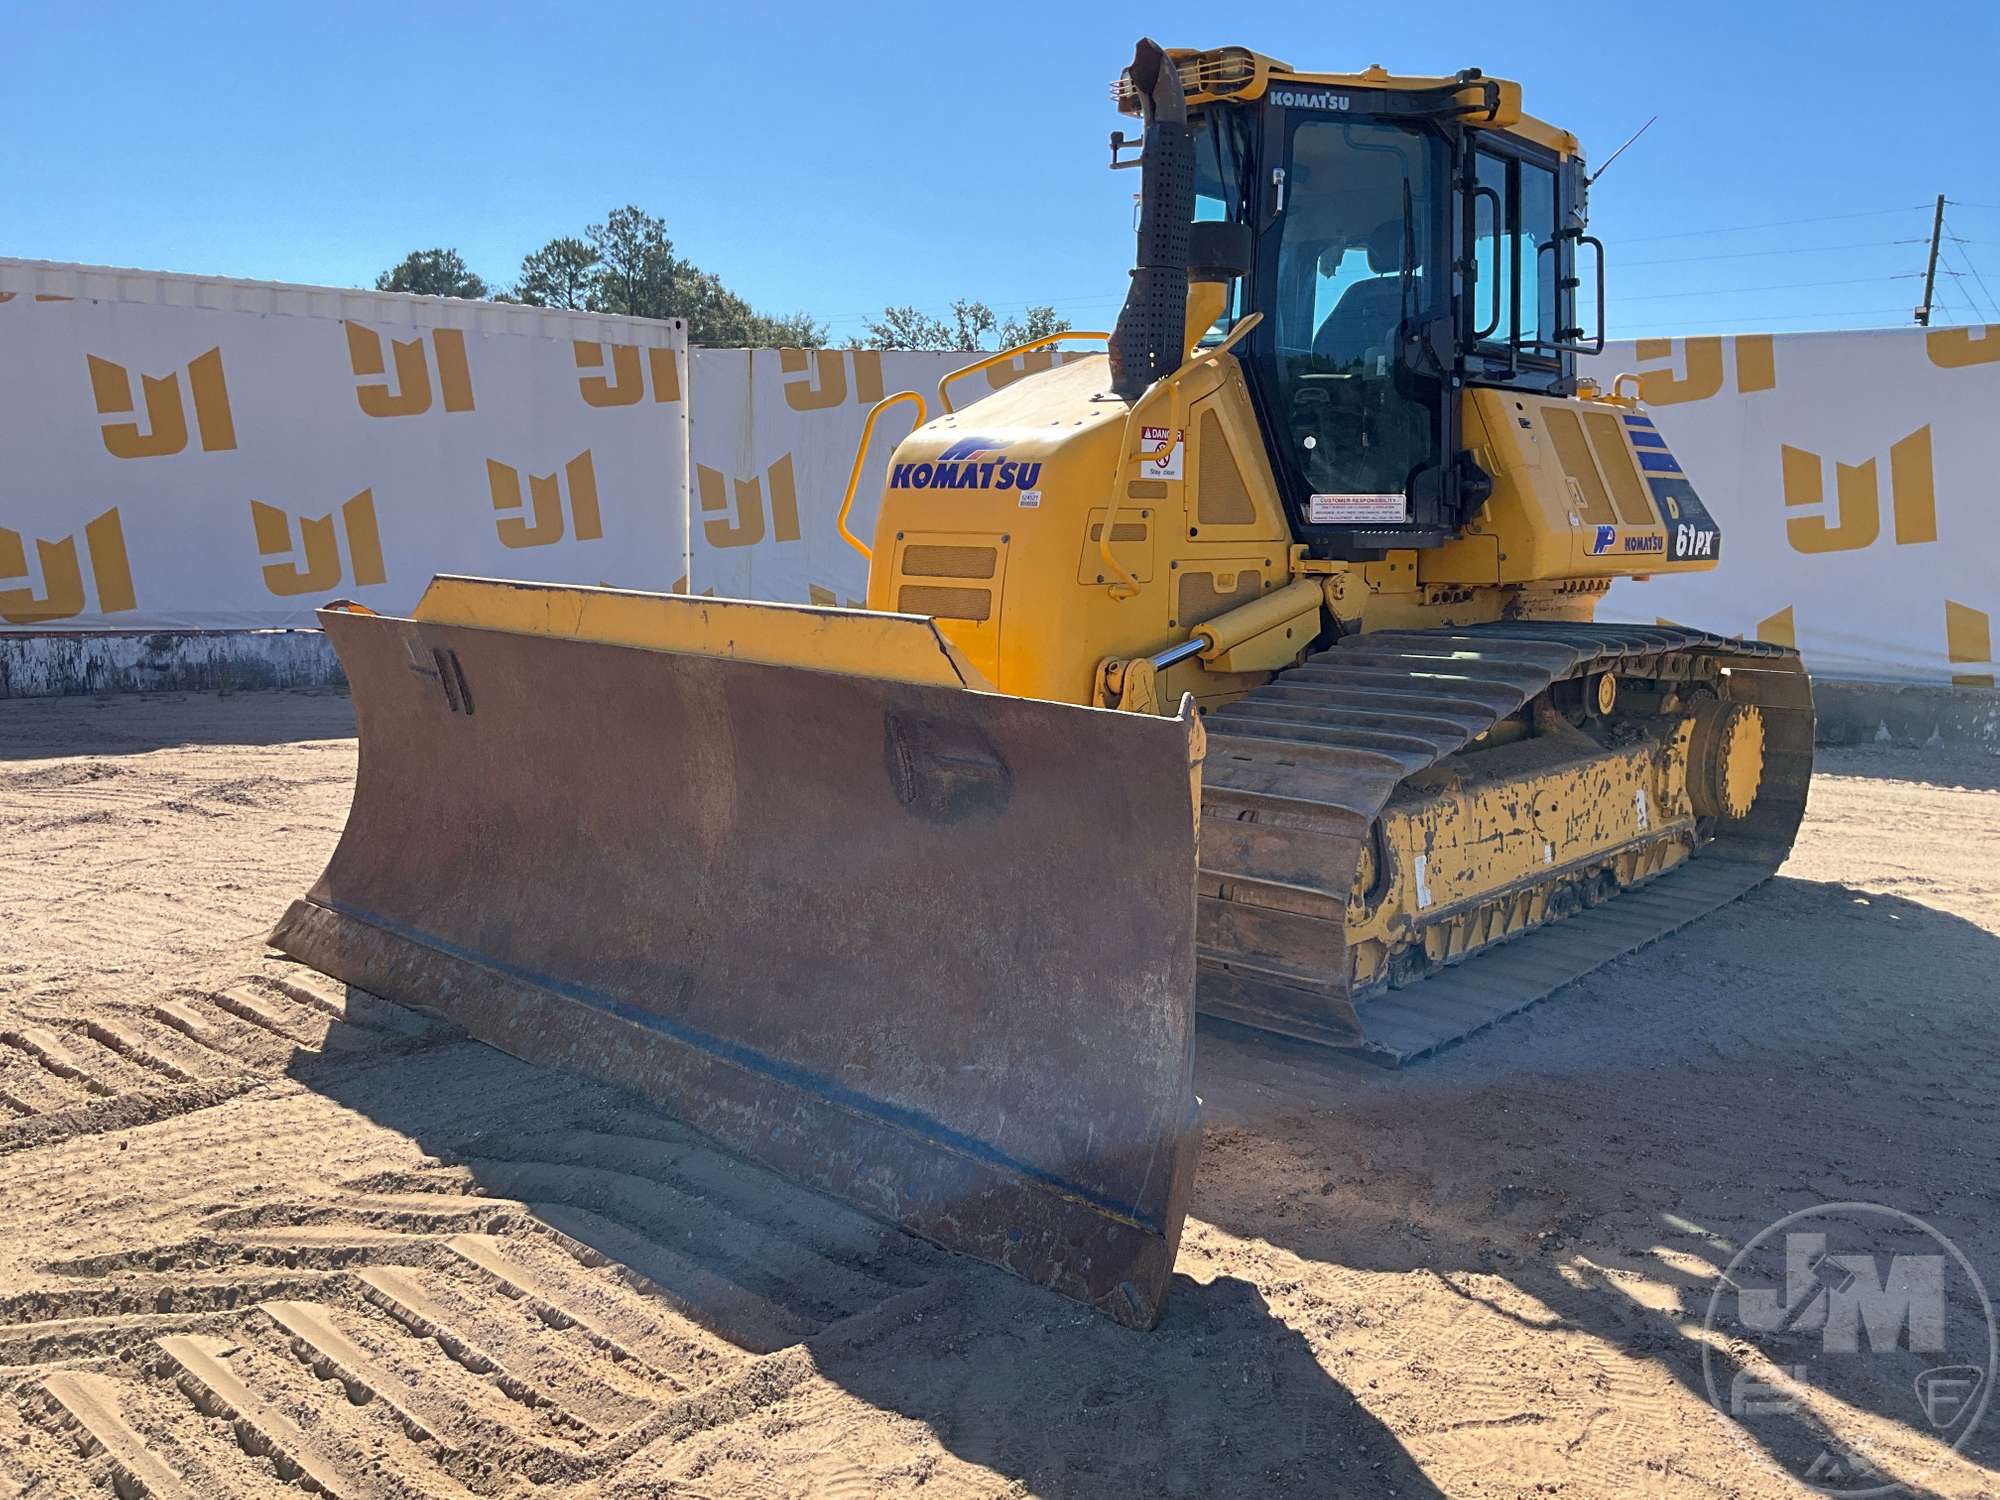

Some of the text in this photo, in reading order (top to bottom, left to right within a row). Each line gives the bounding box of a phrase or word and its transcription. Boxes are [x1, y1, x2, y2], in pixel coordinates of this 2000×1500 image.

[1270, 91, 1350, 110] KOMATSU
[1152, 429, 1182, 440] DANR
[890, 456, 1042, 490] KOMATSU
[1624, 532, 1664, 551] KOMATSU
